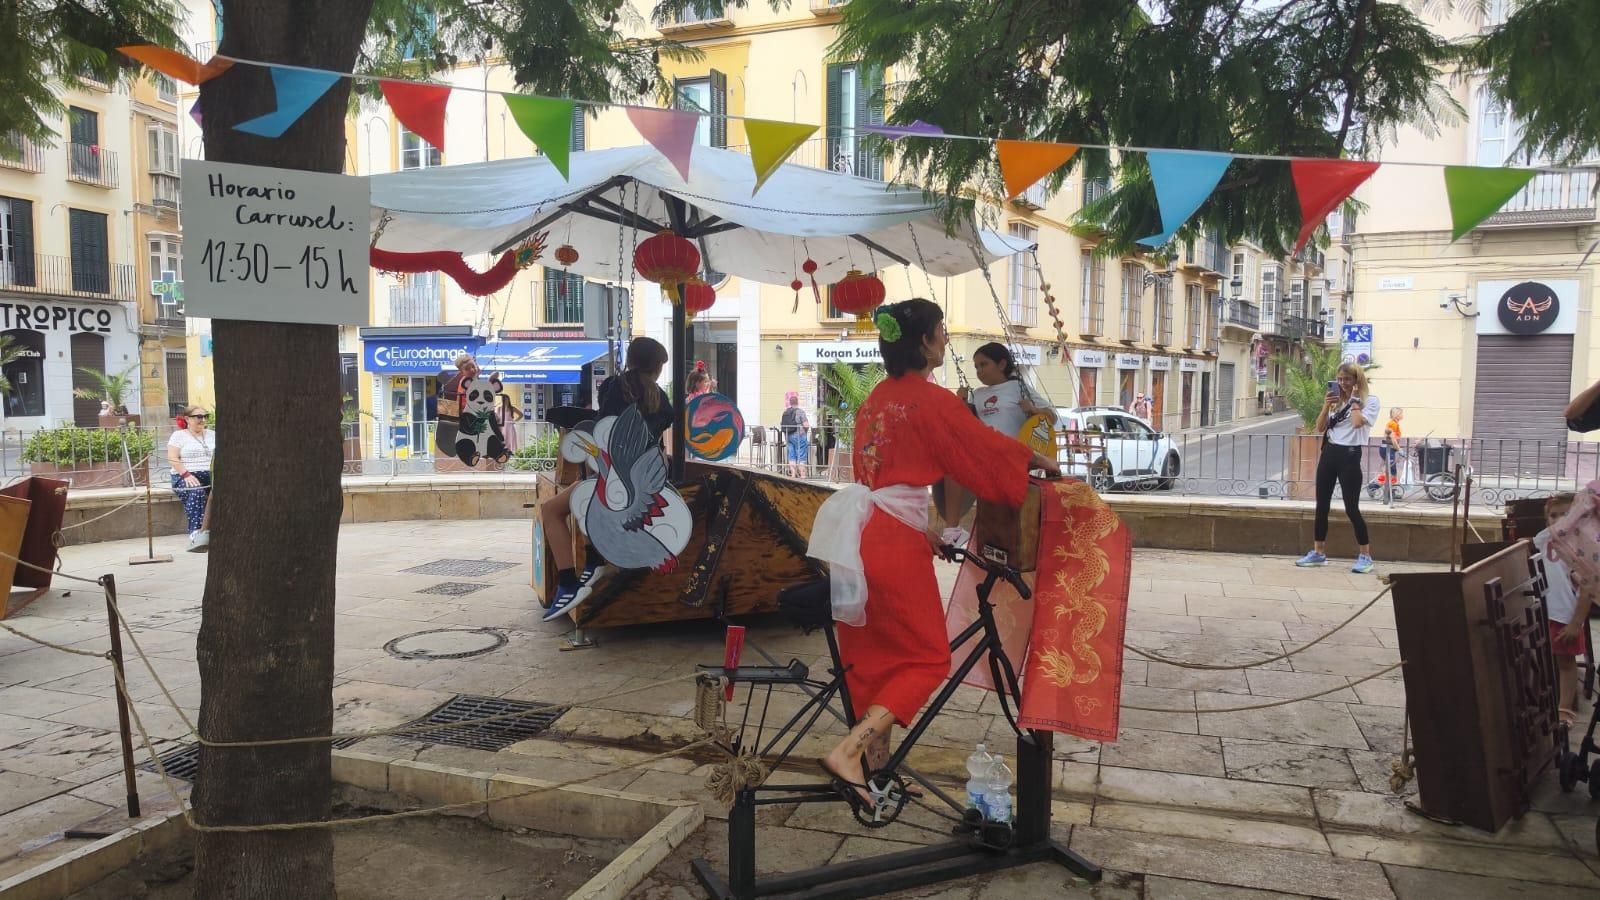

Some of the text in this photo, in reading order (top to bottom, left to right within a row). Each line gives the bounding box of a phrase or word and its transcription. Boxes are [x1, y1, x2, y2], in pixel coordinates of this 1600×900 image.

[208, 173, 296, 200] Horario
[236, 204, 354, 232] Carrusel:
[0, 303, 111, 332] TROPICO
[391, 345, 466, 361] Eurochange
[816, 348, 880, 358] Konan Sush
